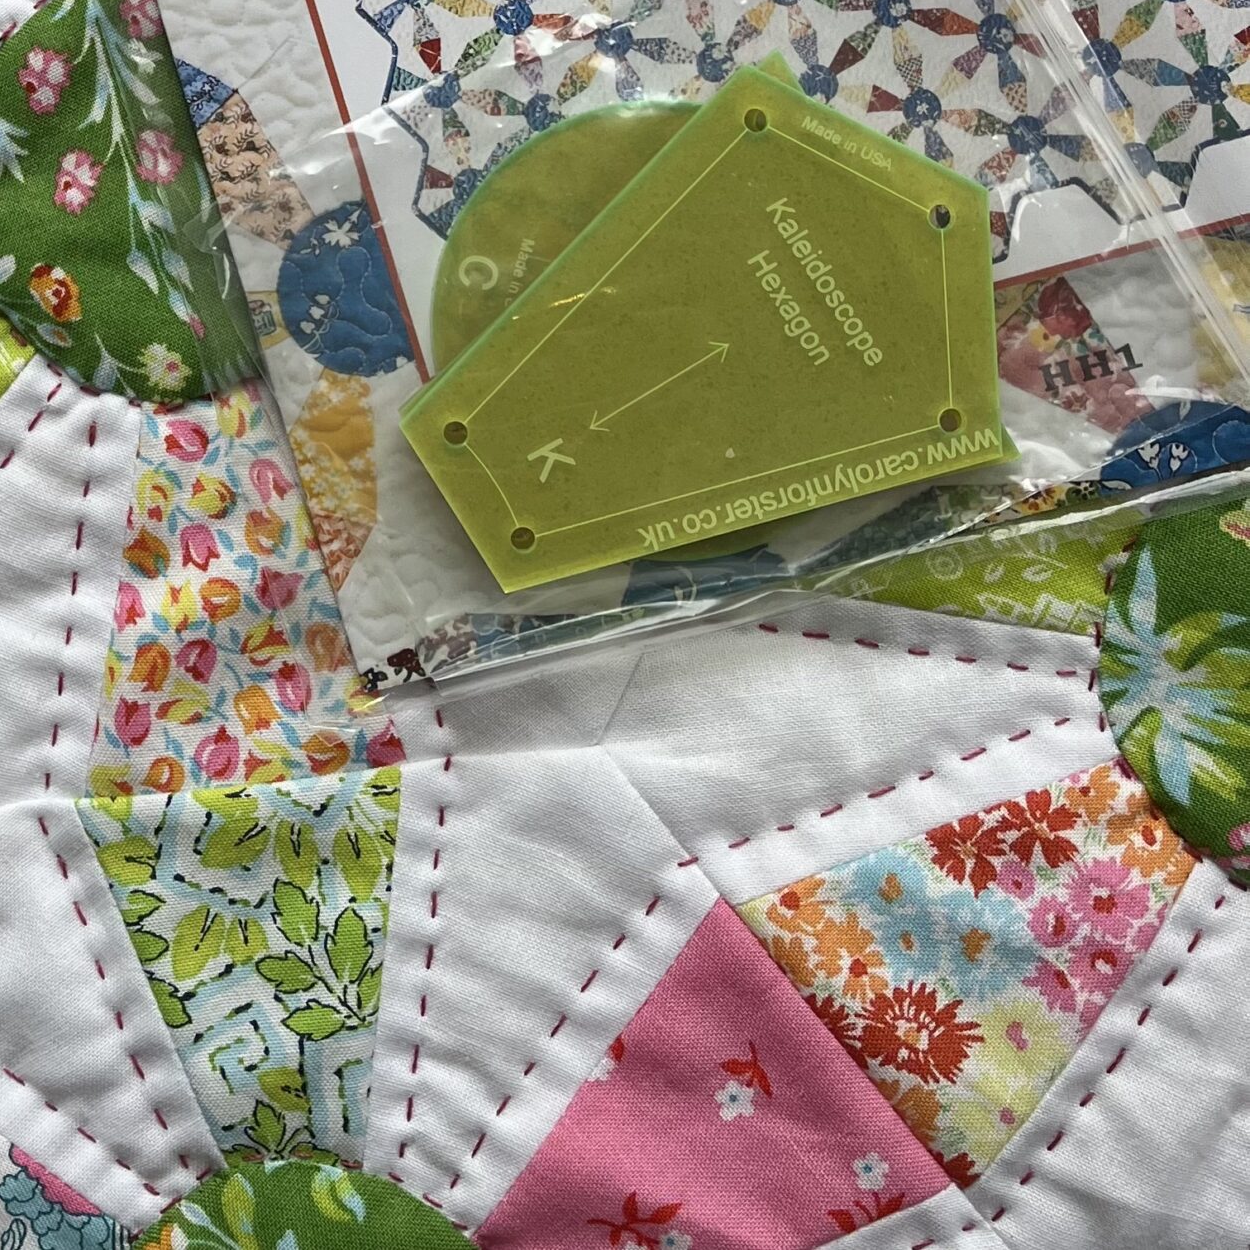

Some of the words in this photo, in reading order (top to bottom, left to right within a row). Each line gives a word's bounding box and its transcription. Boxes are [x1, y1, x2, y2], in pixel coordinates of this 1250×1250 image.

[801, 116, 842, 145] Made
[843, 138, 858, 154] in
[860, 142, 892, 171] USA
[458, 254, 499, 291] C
[512, 237, 535, 278] Made
[765, 197, 883, 367] Kaleidoscope
[508, 281, 523, 294] in
[747, 249, 831, 366] Hexagon
[1038, 343, 1144, 393] HH1
[526, 437, 577, 484] K
[636, 426, 1000, 551] www.carolynforster.co.uk
